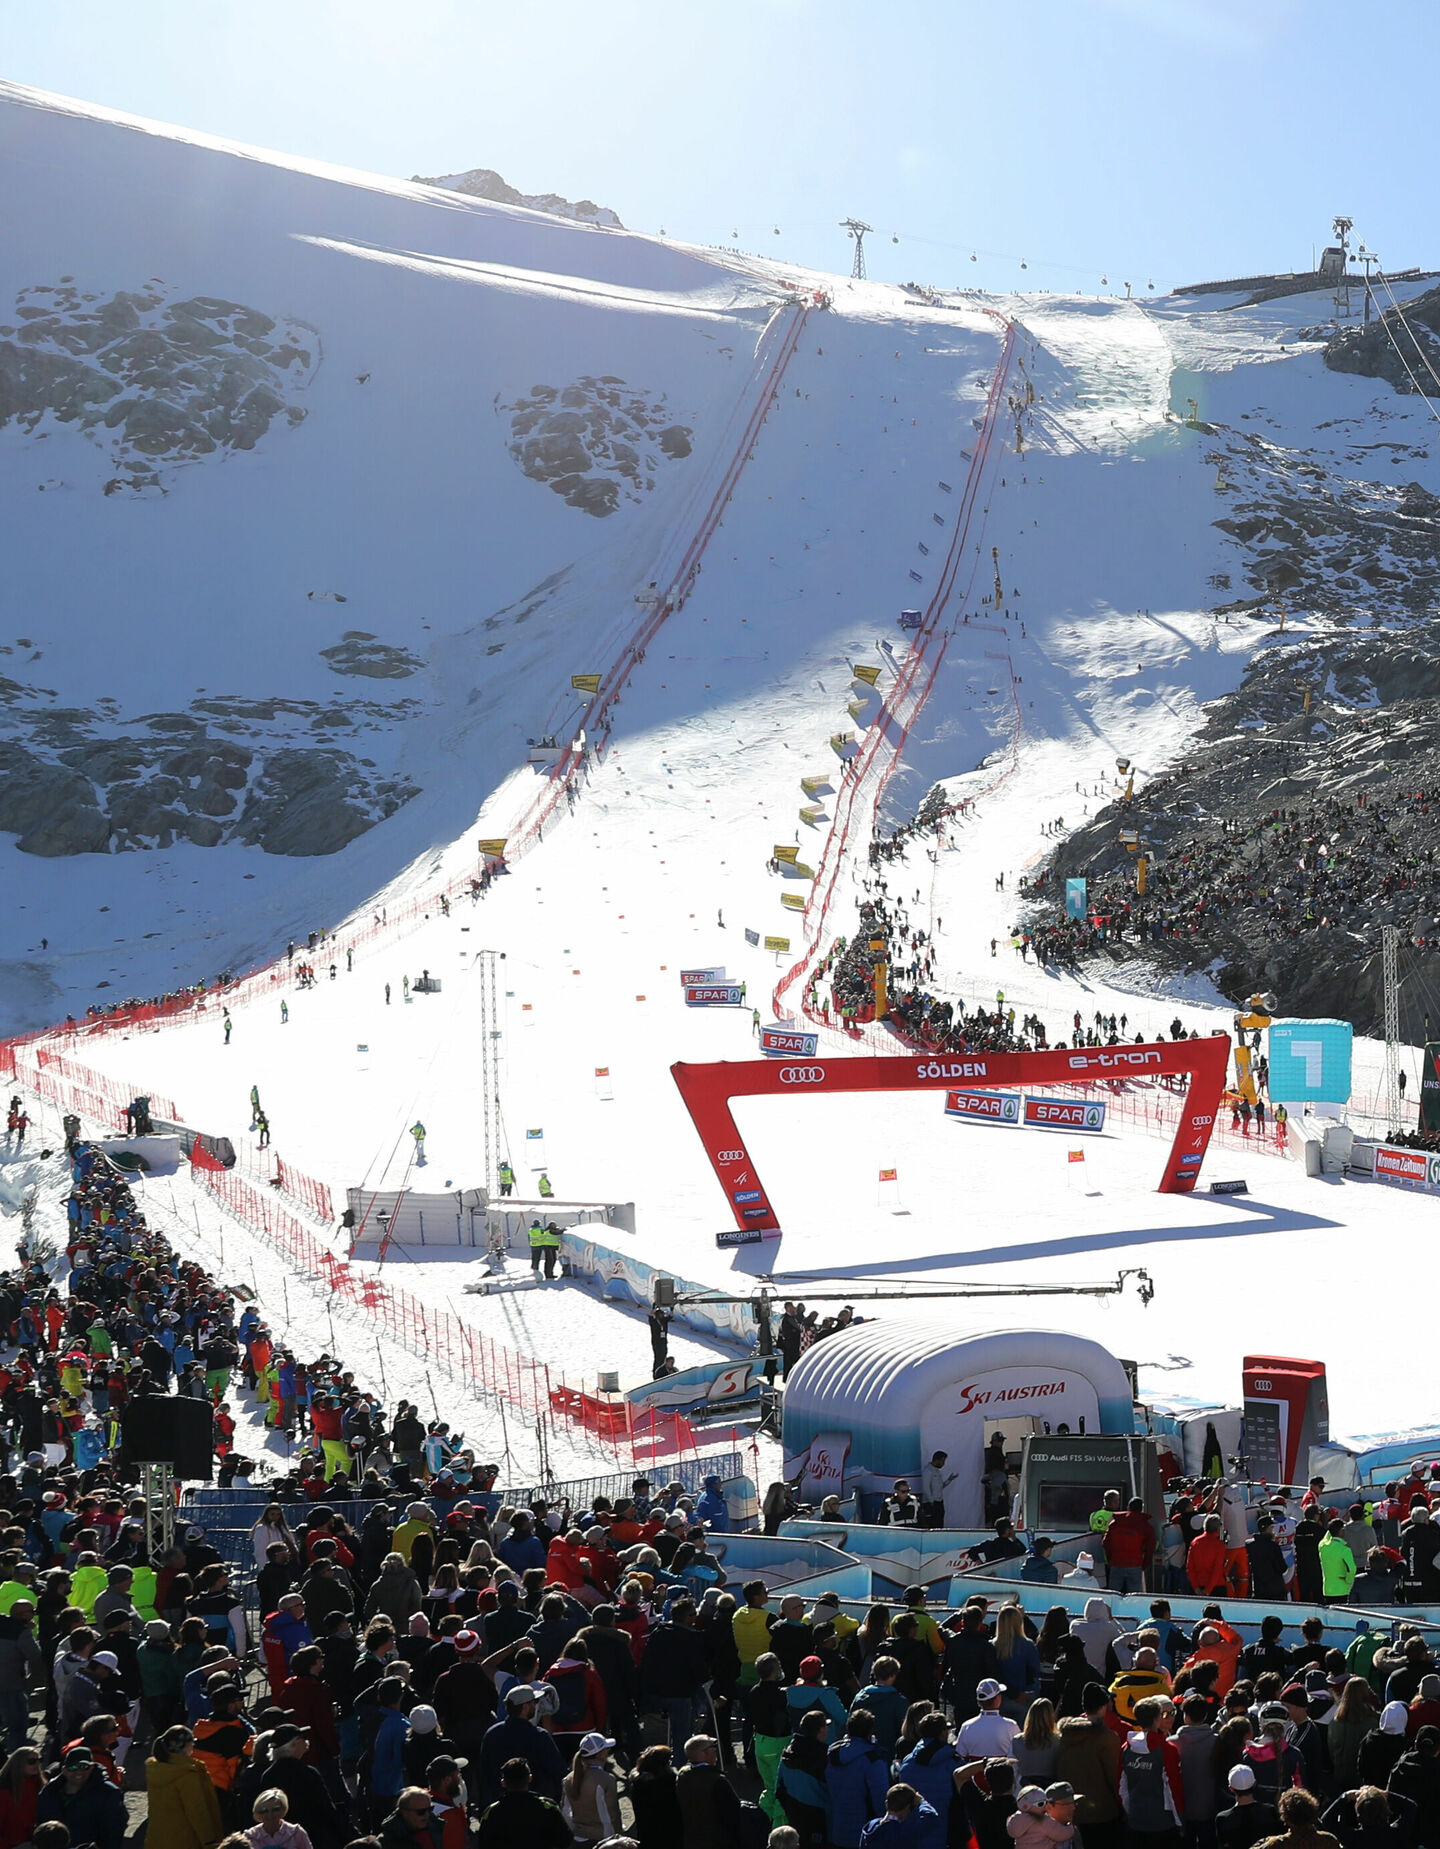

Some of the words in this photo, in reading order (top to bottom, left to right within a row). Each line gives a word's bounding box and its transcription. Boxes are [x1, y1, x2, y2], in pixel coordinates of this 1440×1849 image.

[684, 975, 704, 983] SPAR
[695, 991, 728, 1000] SPAR
[769, 1036, 803, 1049] SPAR
[1068, 1051, 1161, 1069] e-tron
[1291, 1041, 1323, 1088] 1
[917, 1061, 987, 1079] SÖLDEN
[957, 1096, 1000, 1114] SPAR
[1036, 1105, 1083, 1122] SPAR
[1377, 1153, 1400, 1171] Kronen
[1400, 1157, 1427, 1178] Zeitung
[1214, 1182, 1245, 1190] LONGINES
[736, 1192, 759, 1202] SÖLDEN
[718, 1231, 760, 1240] LONGINES
[956, 1384, 992, 1414] SKI
[996, 1381, 1065, 1401] AUSTRIA
[1254, 1647, 1266, 1655] ITA
